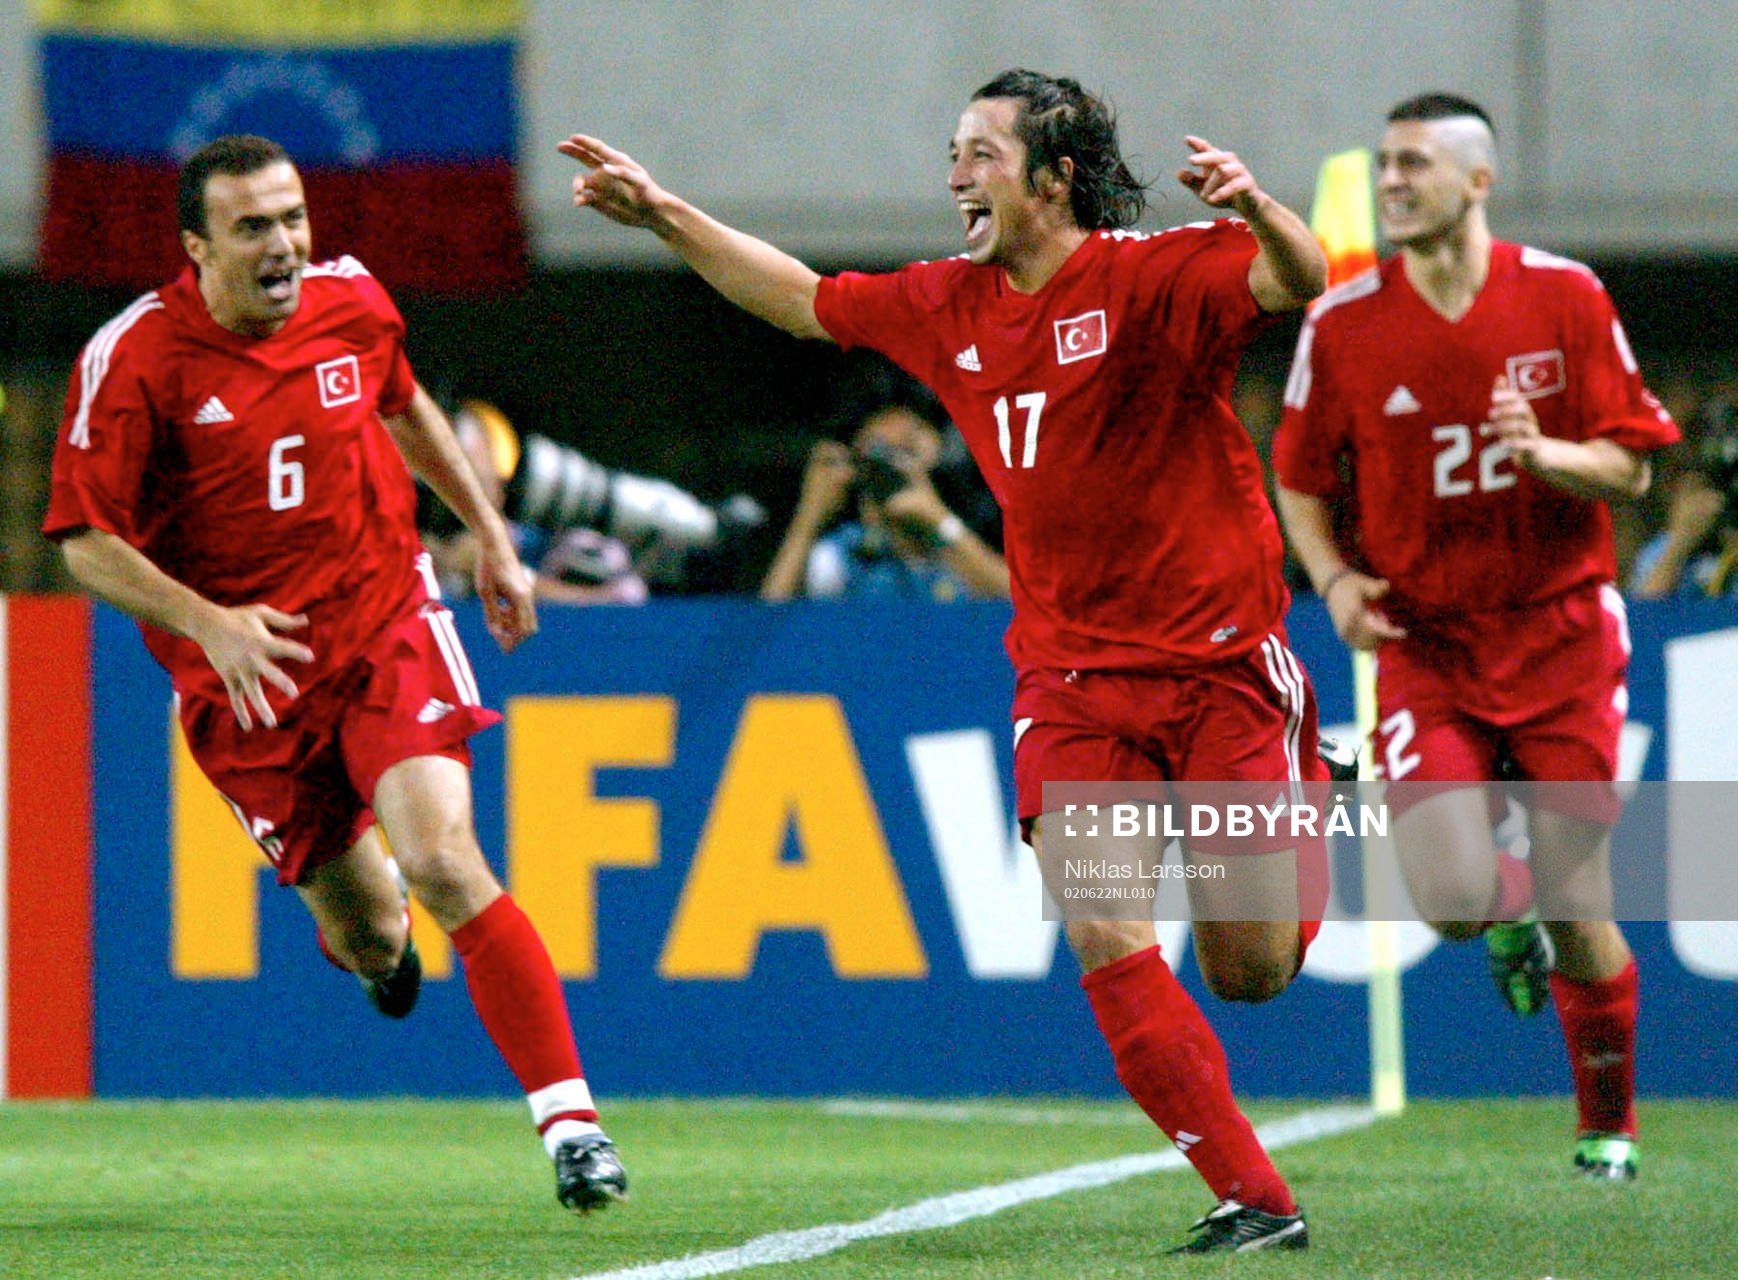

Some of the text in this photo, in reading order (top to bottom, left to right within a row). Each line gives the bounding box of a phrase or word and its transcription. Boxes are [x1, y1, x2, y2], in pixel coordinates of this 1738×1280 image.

[992, 391, 1047, 469] 17
[1432, 423, 1518, 498] 22
[268, 434, 305, 512] 6
[170, 695, 928, 982] FFA
